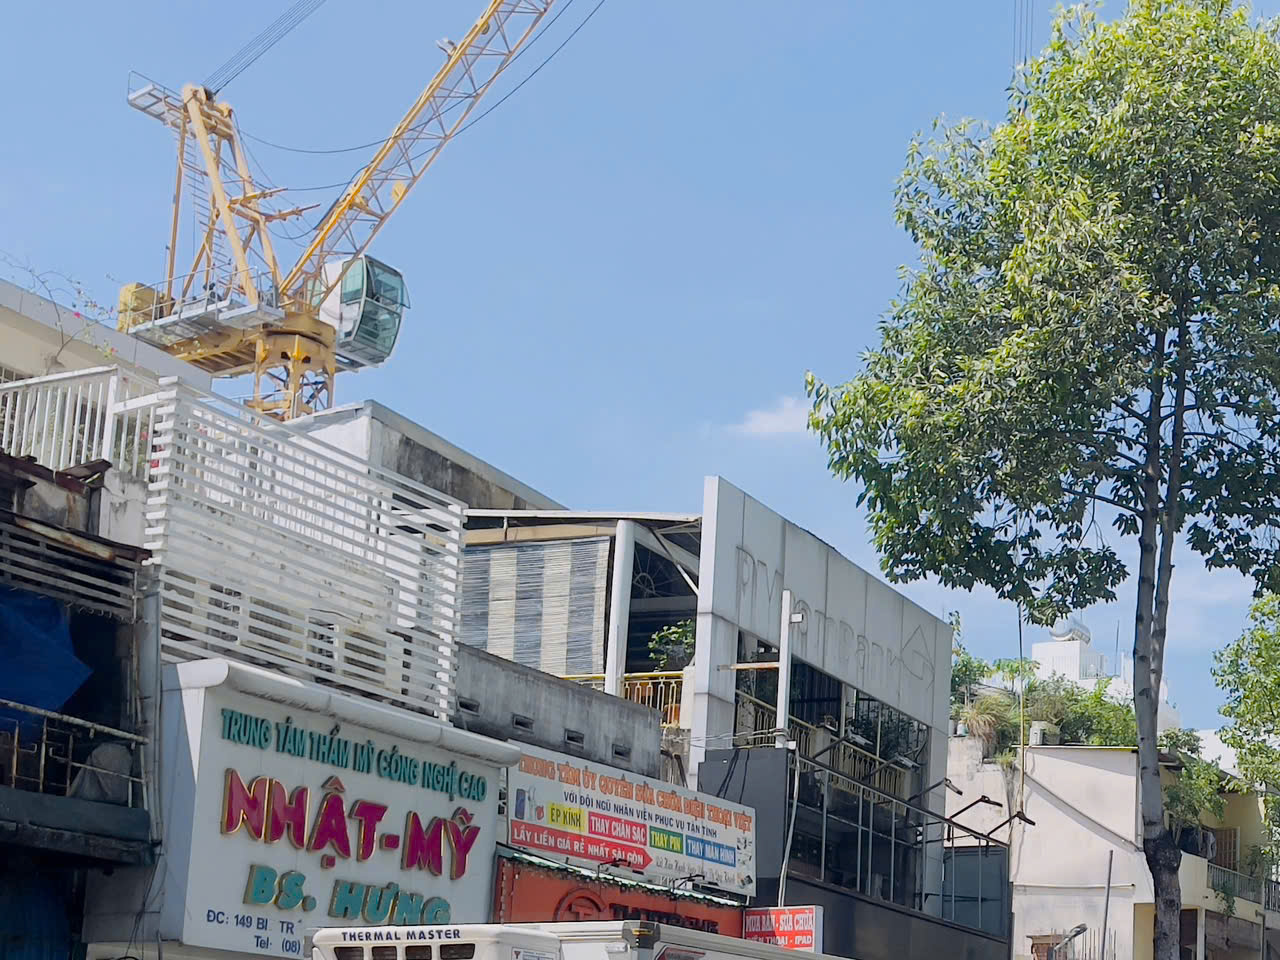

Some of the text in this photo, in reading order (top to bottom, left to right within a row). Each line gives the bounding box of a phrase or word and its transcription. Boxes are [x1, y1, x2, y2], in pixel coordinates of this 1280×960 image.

[221, 708, 272, 750] TRUNG
[459, 771, 487, 801] CAO
[563, 807, 581, 828] KÍNH
[591, 815, 610, 834] THAY
[651, 831, 681, 851] THAY PIN
[688, 839, 703, 857] THAY
[244, 864, 317, 911] BS.
[234, 914, 252, 928] 149
[342, 929, 460, 941] THERMAL MASTER
